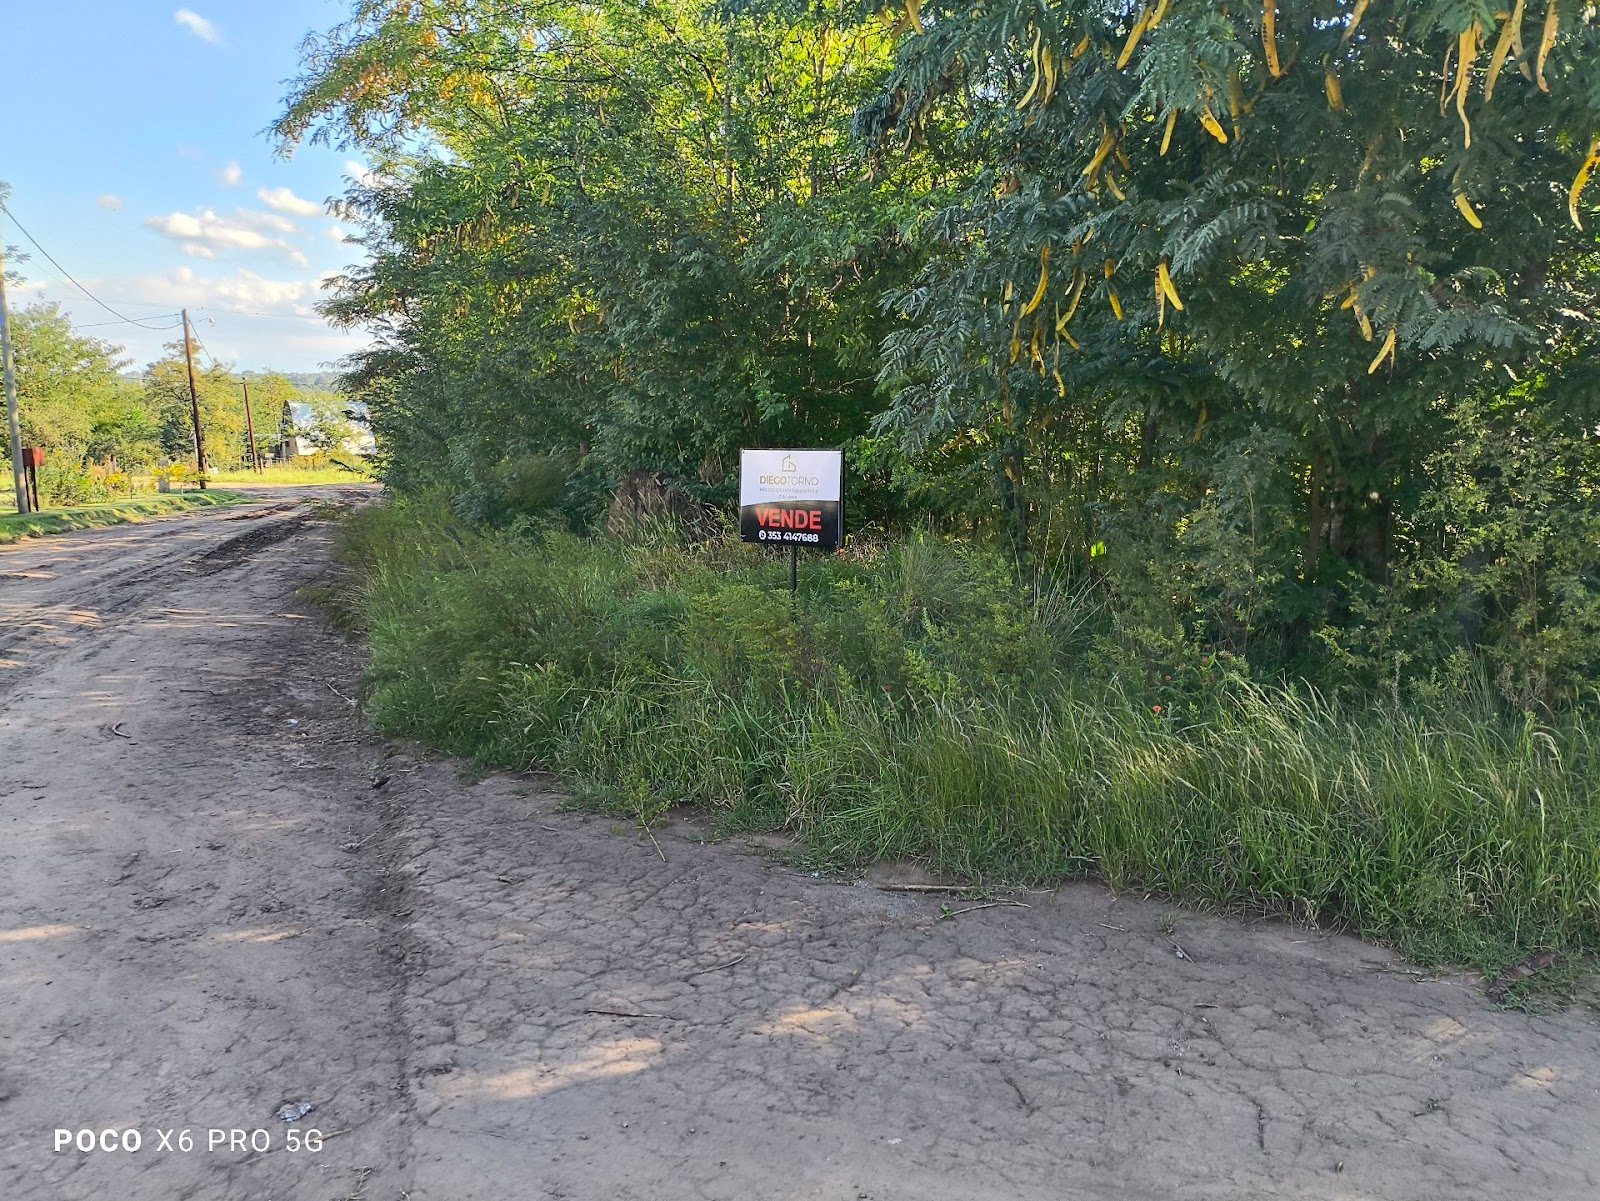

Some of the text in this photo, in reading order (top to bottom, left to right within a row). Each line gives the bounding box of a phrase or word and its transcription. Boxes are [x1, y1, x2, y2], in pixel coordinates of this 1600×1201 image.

[755, 507, 822, 530] VENDE
[767, 531, 819, 542] 353 4147688
